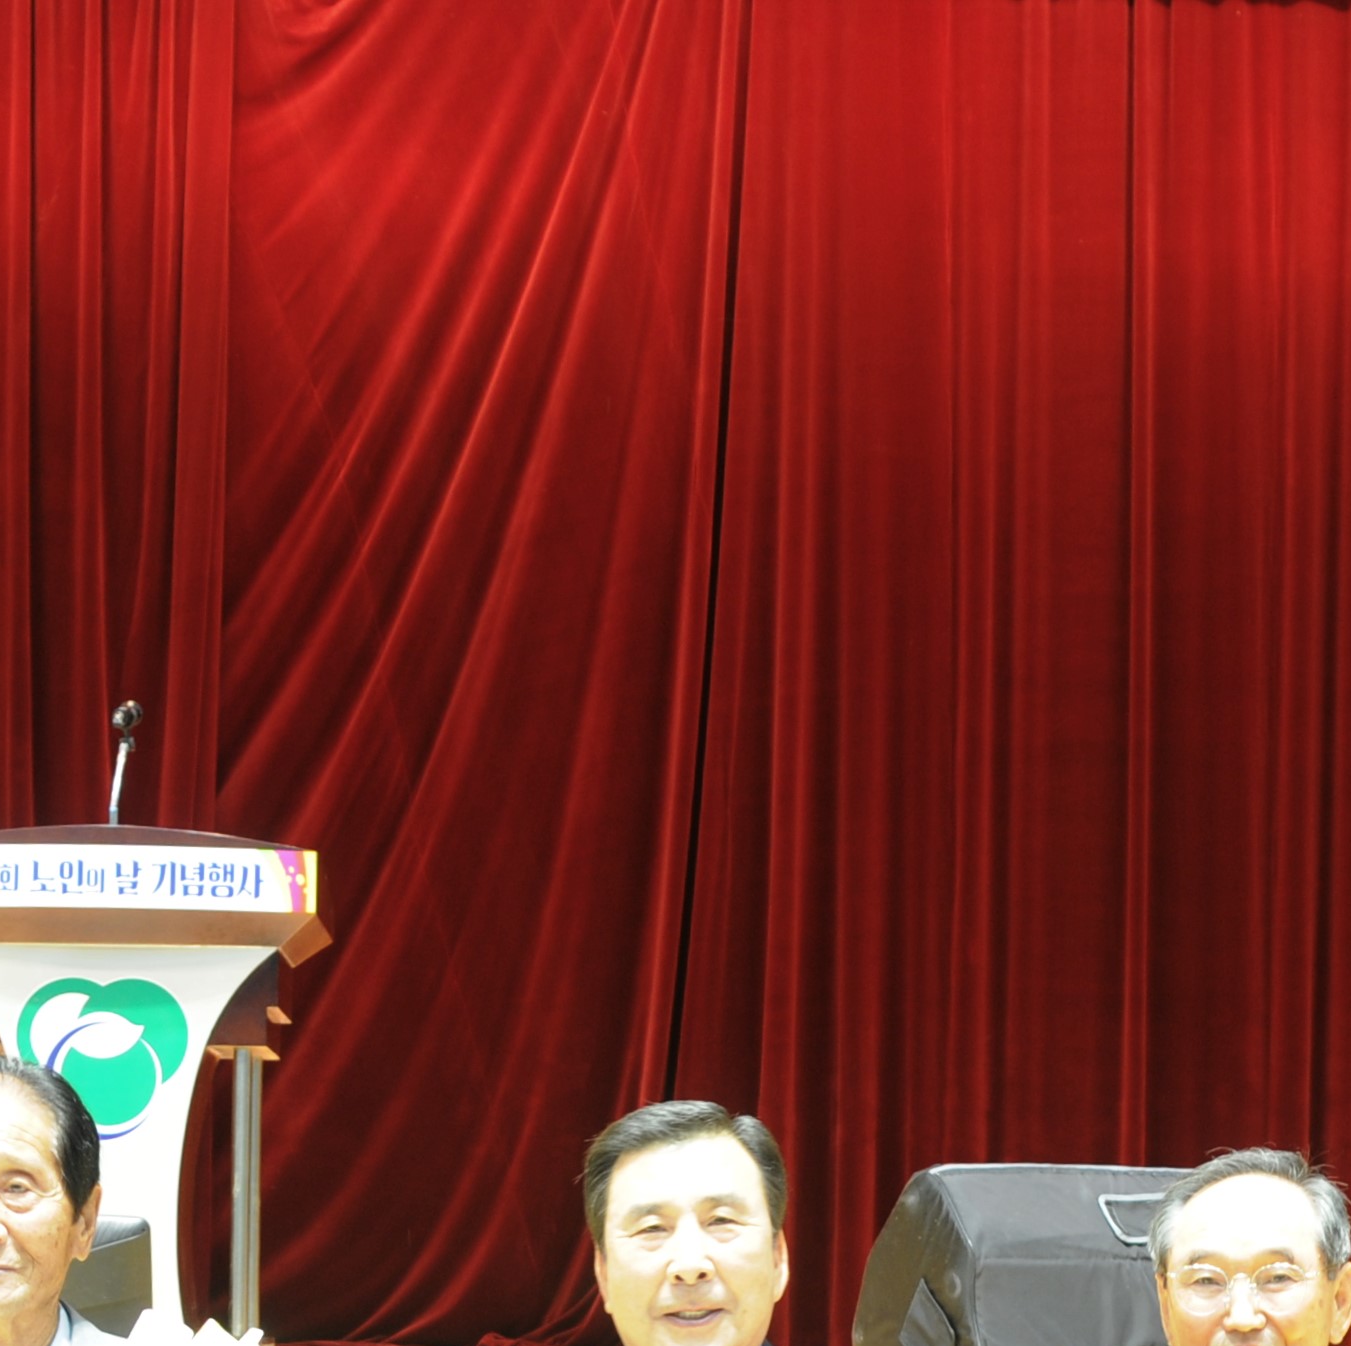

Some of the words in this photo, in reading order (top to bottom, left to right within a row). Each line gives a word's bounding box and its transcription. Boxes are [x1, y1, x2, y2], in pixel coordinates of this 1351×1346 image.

[30, 859, 105, 895] 노인의
[115, 860, 143, 896] 날
[151, 860, 264, 899] 기념행사
